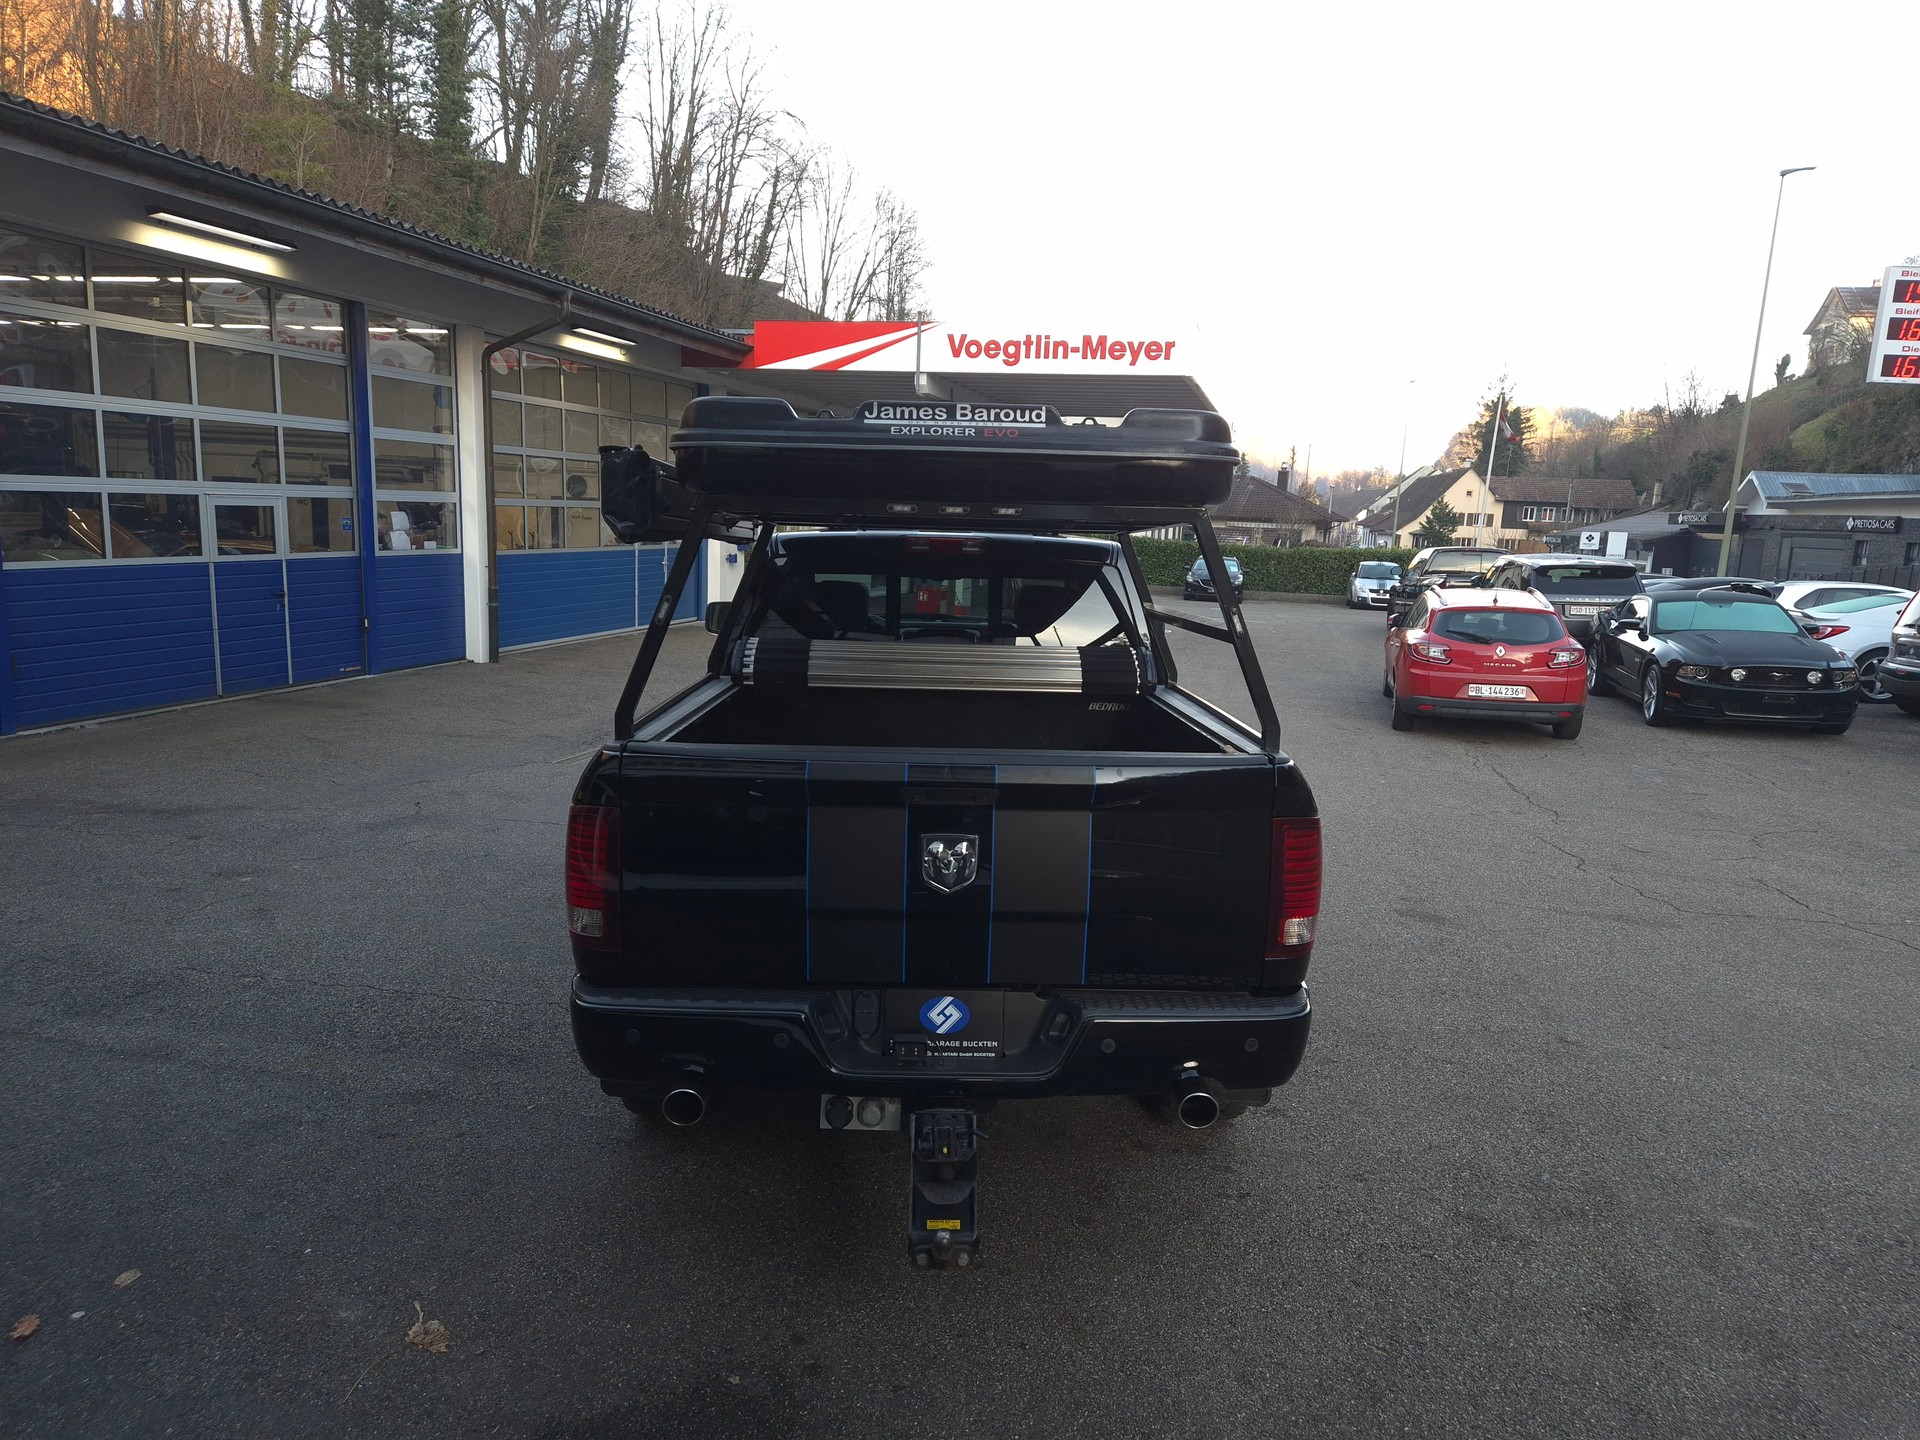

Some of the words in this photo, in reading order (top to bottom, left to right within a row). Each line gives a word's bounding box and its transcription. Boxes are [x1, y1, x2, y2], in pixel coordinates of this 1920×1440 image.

[947, 334, 1175, 367] Voegtlin-Meyer
[1892, 356, 1920, 377] 1.6
[864, 401, 947, 420] James
[955, 403, 1046, 423] Baroud
[890, 426, 975, 437] EXPLORER
[983, 428, 1019, 438] EVO
[1854, 519, 1880, 528] PRETIOSA
[1880, 520, 1895, 529] CARS
